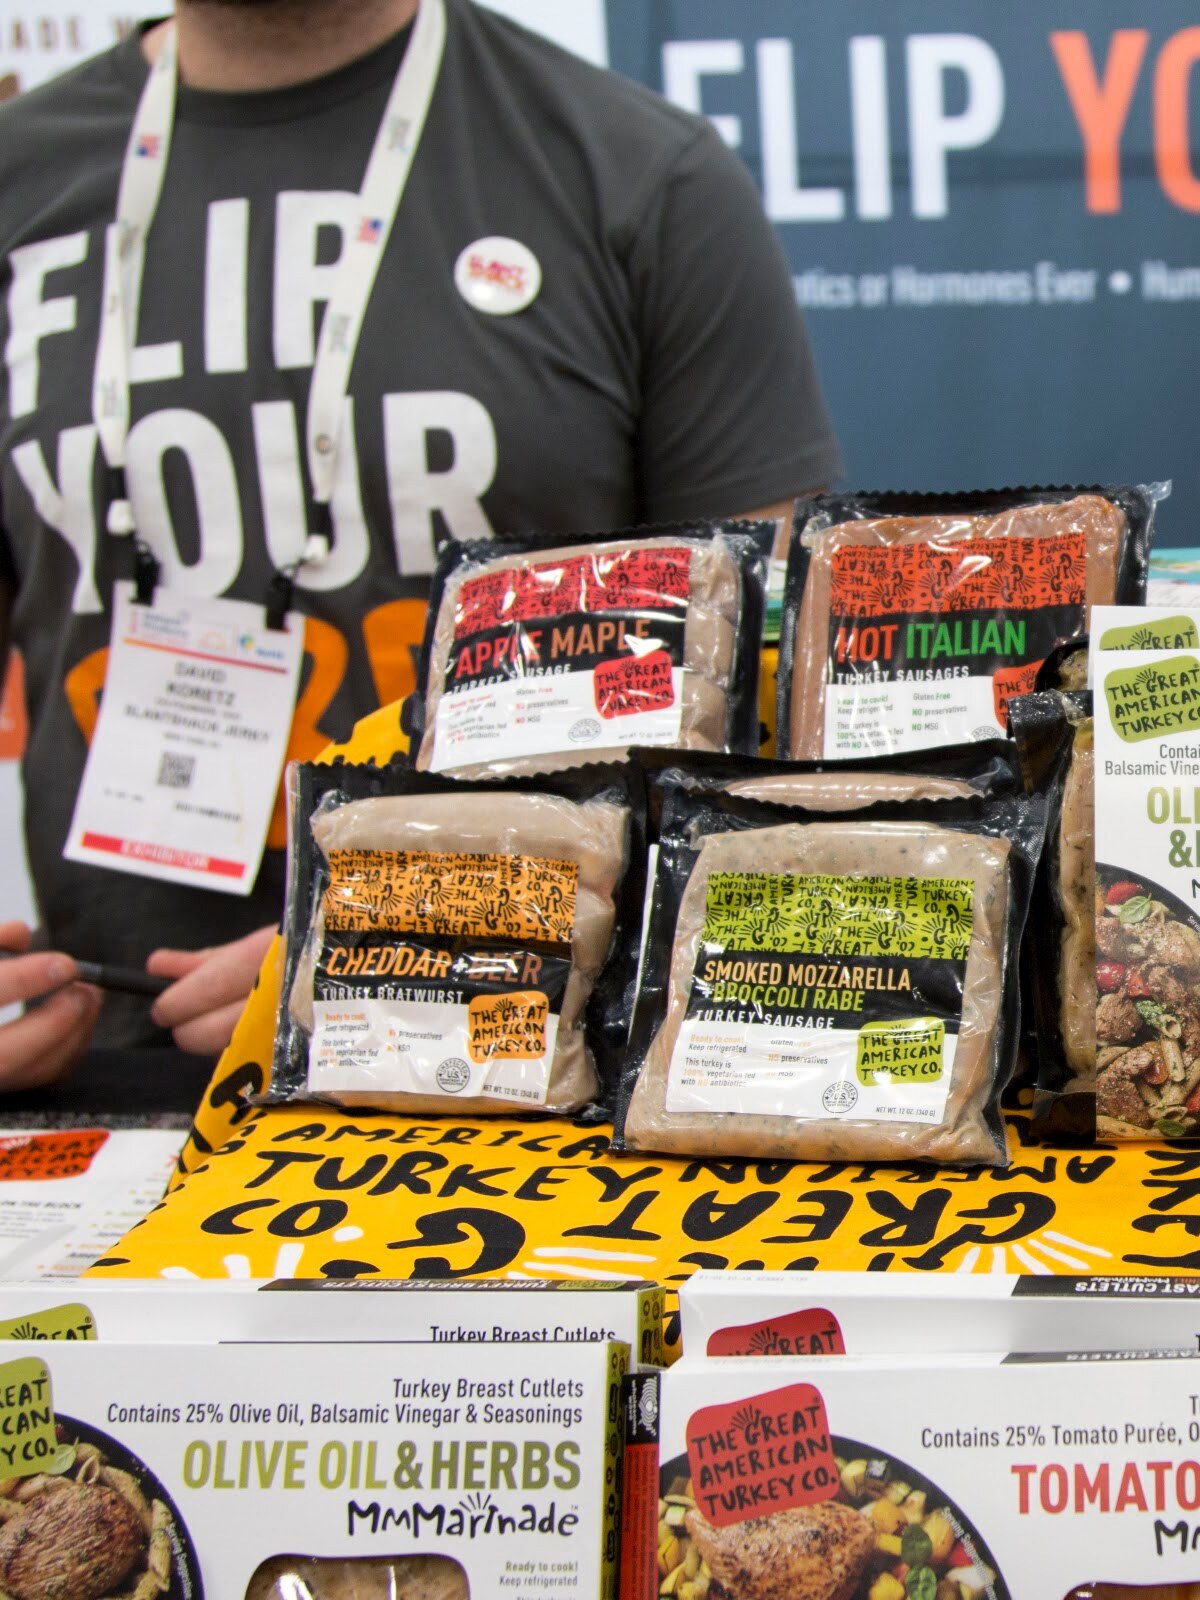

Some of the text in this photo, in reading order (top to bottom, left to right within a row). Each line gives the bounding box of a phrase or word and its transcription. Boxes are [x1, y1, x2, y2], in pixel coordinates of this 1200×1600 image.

[662, 33, 1005, 222] FLIP
[890, 264, 1032, 305] Hormones
[1035, 260, 1097, 304] Ever
[11, 390, 498, 614] YOUR
[837, 620, 1026, 664] HOT ITALIAN
[896, 665, 970, 683] SAUSAGES
[1107, 667, 1200, 701] THE GREAT
[1118, 710, 1184, 737] TURKEY
[1105, 760, 1167, 776] Balsamic
[325, 946, 452, 979] CHEDDAR
[704, 959, 912, 992] SMOKED MOZZARELLA
[377, 987, 464, 1005] BRATWURST
[813, 988, 866, 1012] RABE
[696, 1009, 835, 1030] TURKEY SAUSAGE
[244, 1149, 666, 1203] TURKEY
[394, 1378, 584, 1402] Turkey Breast Cutlets
[107, 1402, 583, 1428] Contains 25% Olive Oil, Balsamic Vinegar & Seasonings
[691, 1404, 822, 1460] THE GREAT
[921, 1426, 1000, 1449] Contains
[1006, 1425, 1046, 1447] 25%
[1052, 1424, 1118, 1446] Tomato
[1125, 1421, 1183, 1446] Purée,
[182, 1439, 309, 1490] OLIVE
[318, 1440, 387, 1491] OIL
[700, 1433, 829, 1490] AMERICAN
[703, 1466, 837, 1517] TURKEY CO.
